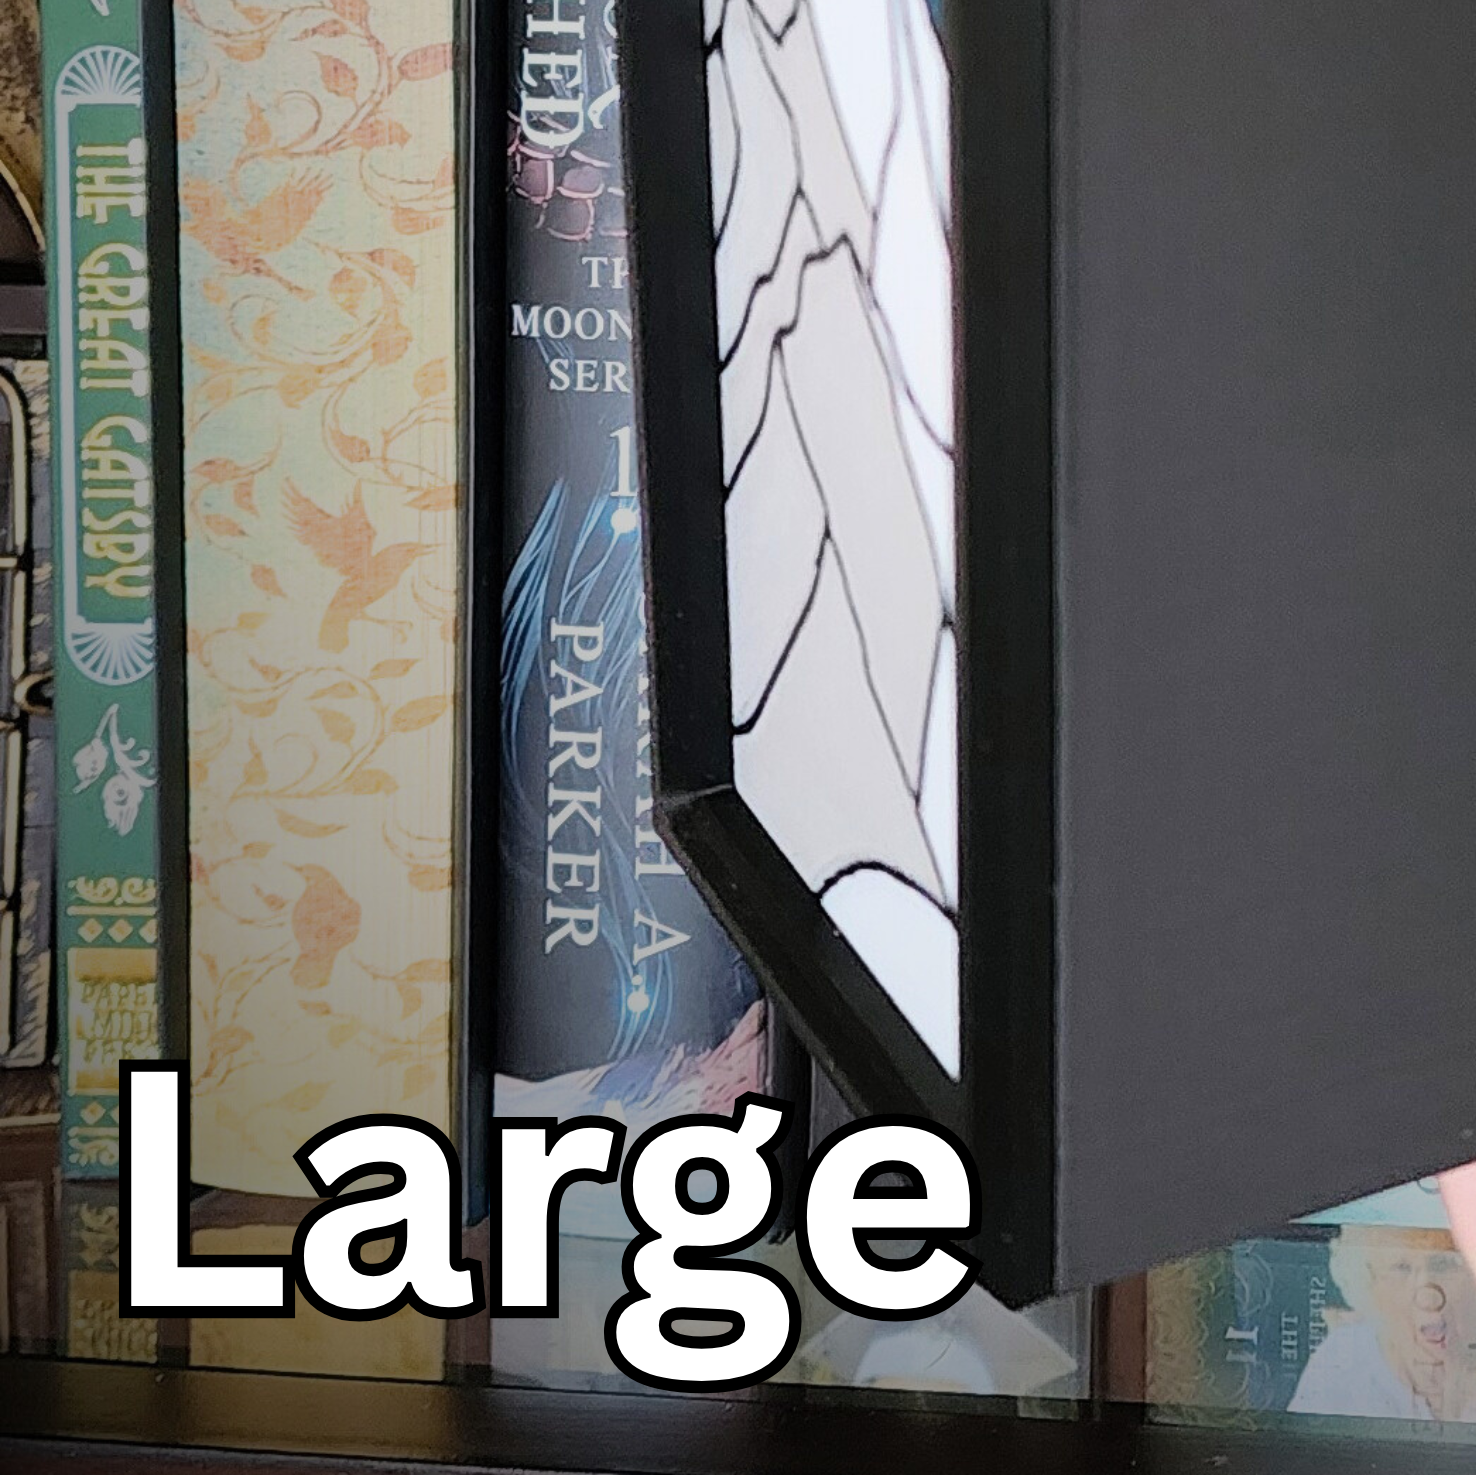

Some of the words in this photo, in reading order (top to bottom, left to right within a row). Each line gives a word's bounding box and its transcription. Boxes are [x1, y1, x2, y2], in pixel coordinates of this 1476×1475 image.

[76, 137, 147, 224] THE
[78, 242, 150, 398] GREAT
[81, 415, 151, 598] GATSBY
[610, 426, 638, 497] 1
[544, 617, 604, 954] PARKER
